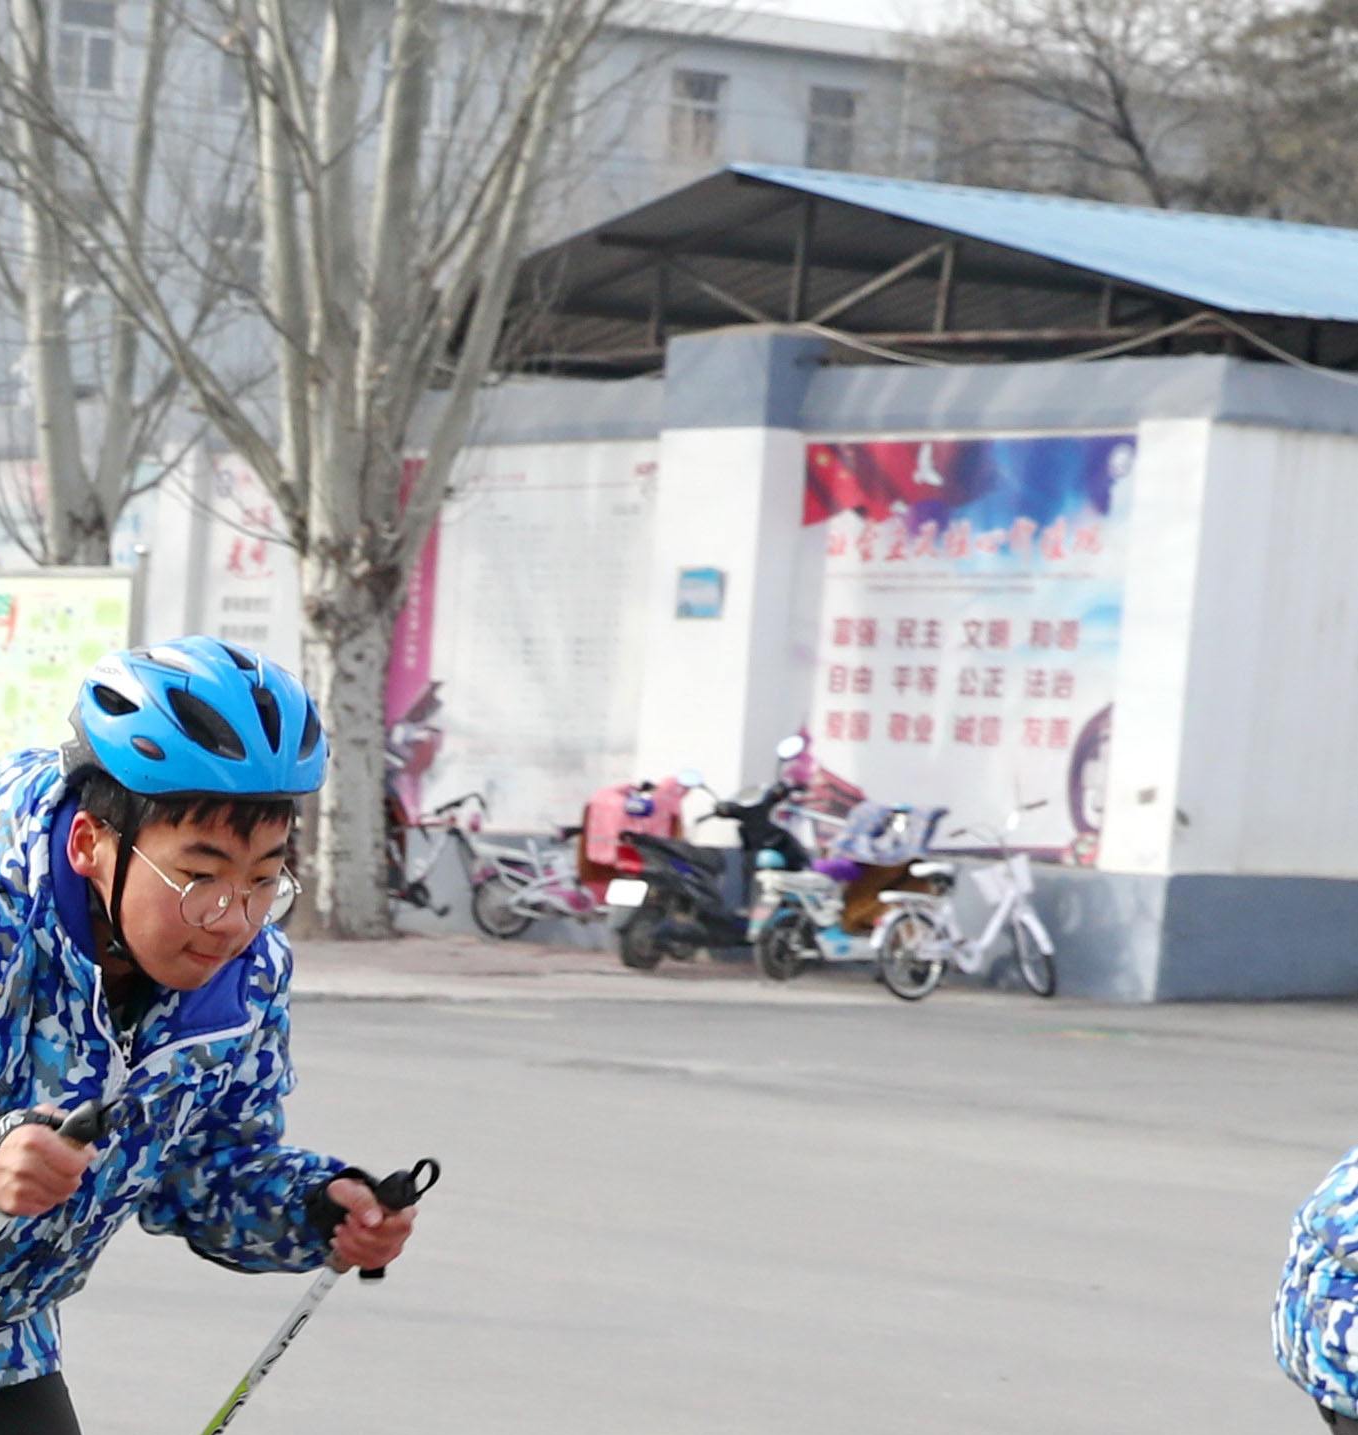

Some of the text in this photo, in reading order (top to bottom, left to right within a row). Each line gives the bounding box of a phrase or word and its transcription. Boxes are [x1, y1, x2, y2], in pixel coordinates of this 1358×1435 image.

[833, 618, 877, 647] 富强
[896, 618, 940, 648] 民主
[962, 619, 1010, 648] 文明
[828, 664, 1075, 699] 自由 平等 公正 法治
[826, 711, 1072, 748] 爱国 敬业 诚信 友善
